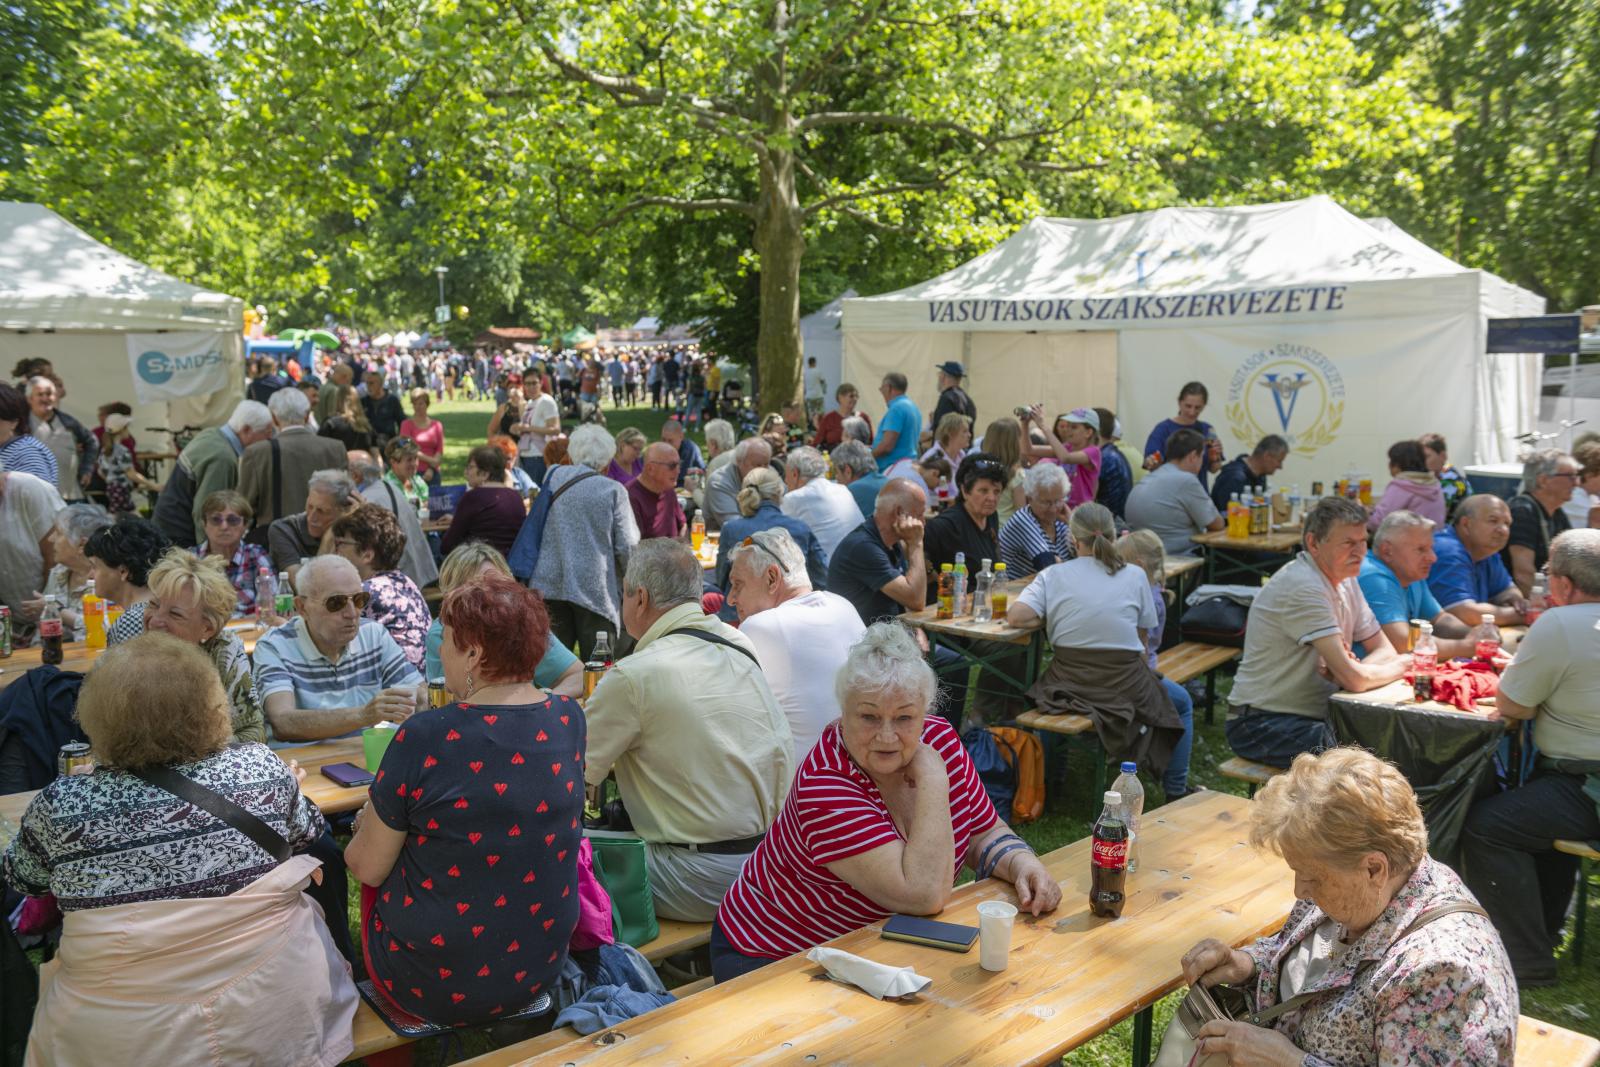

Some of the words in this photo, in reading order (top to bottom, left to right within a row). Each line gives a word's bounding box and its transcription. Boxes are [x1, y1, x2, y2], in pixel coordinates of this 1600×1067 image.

[928, 298, 1073, 323] VASUTASOK
[1080, 287, 1347, 321] SZAKSZERVEZETE
[1094, 841, 1125, 857] Coca-Cola
